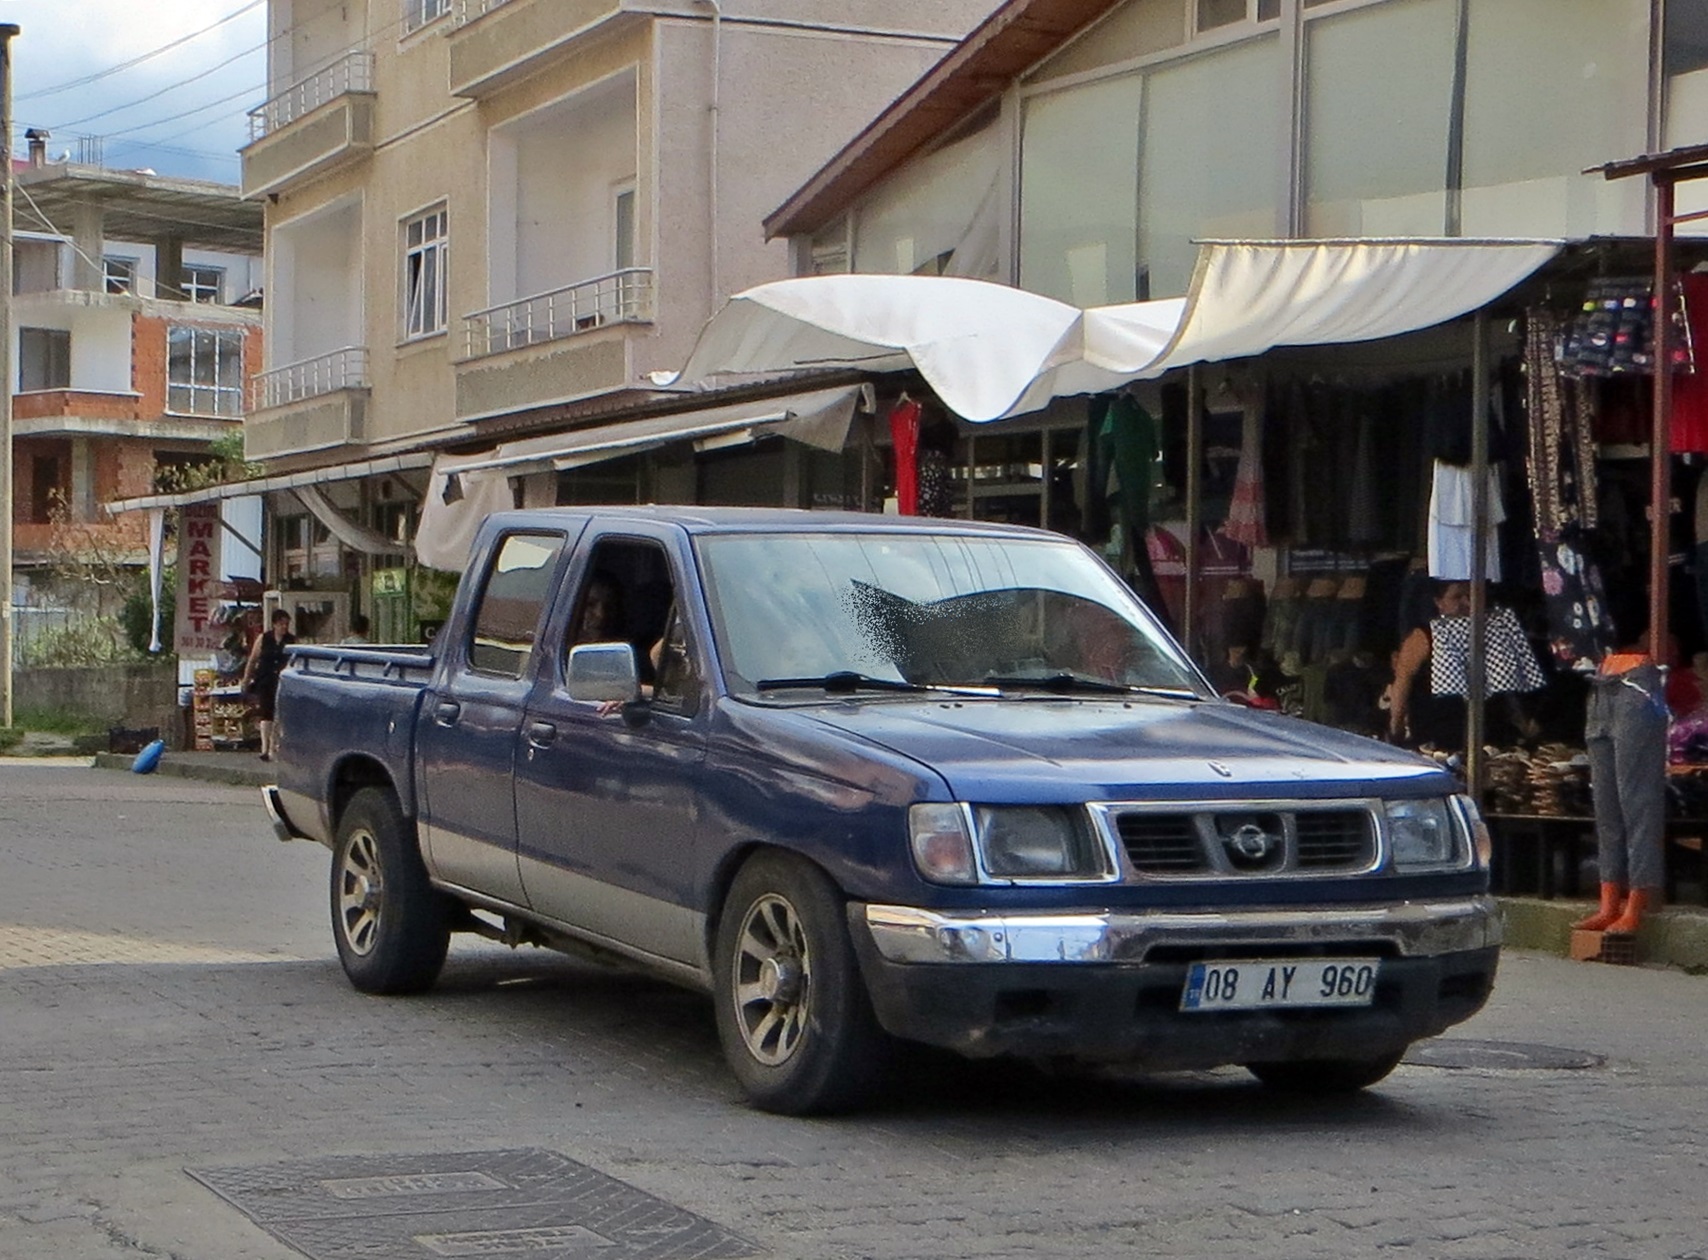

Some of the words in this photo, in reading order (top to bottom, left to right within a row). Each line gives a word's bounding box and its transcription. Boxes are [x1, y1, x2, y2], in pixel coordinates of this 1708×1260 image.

[187, 521, 213, 632] MARKET
[1205, 968, 1239, 1001] 08
[1262, 966, 1296, 1000] AY
[1320, 965, 1373, 998] 960
